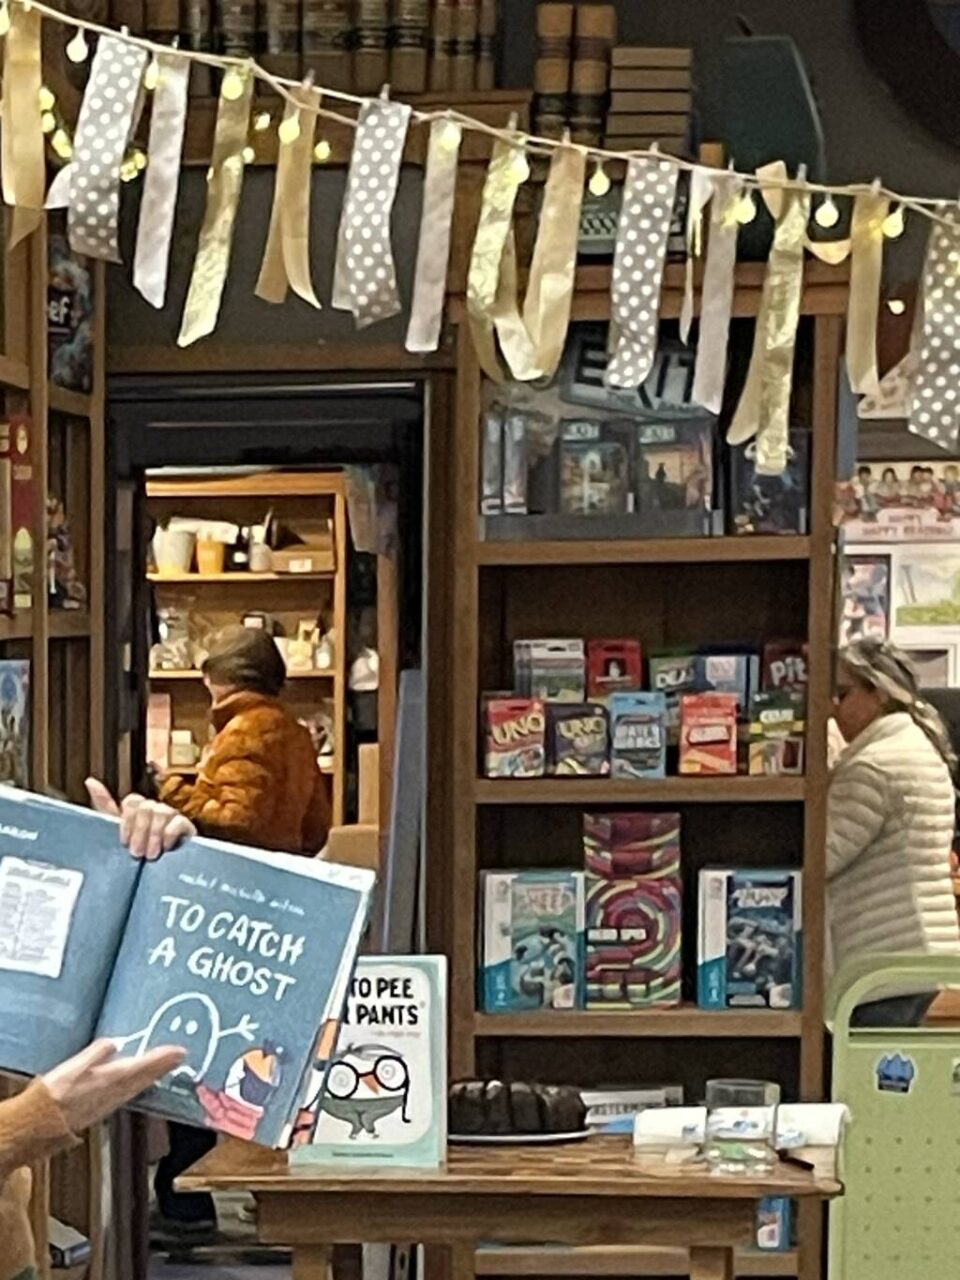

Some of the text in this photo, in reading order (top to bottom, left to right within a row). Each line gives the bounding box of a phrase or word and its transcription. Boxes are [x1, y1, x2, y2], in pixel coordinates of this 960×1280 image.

[491, 711, 545, 745] UNO
[557, 716, 607, 739] UNO
[160, 895, 306, 966] TO CATCH
[148, 936, 297, 1001] A GHOST
[350, 977, 415, 999] TO PEE
[356, 1004, 419, 1025] PANTS
